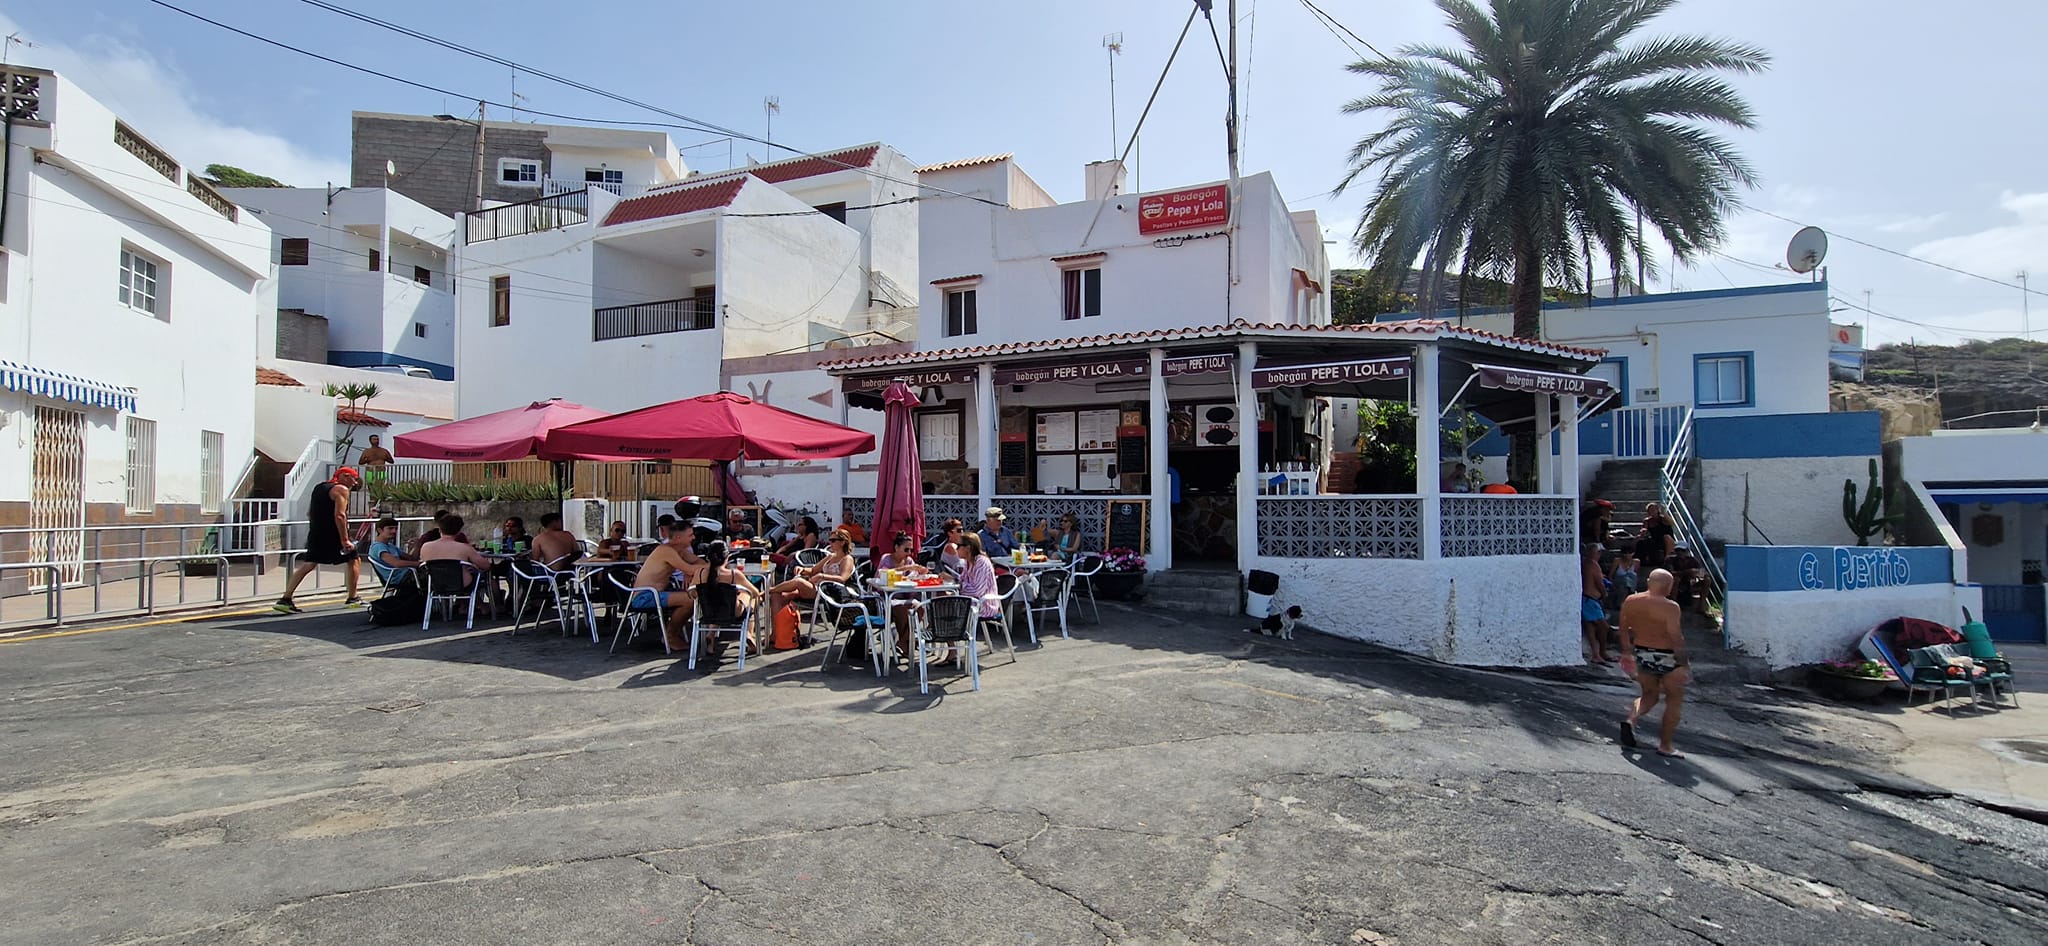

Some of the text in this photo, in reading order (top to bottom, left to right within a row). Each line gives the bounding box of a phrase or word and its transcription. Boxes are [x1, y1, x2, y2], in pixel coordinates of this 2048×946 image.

[1173, 190, 1217, 203] Bodegón
[1167, 200, 1223, 217] Pepe y Lola
[1189, 358, 1203, 370] PEPE
[1204, 358, 1209, 369] Y
[1209, 356, 1226, 368] LOLA
[917, 374, 924, 384] Y
[925, 372, 952, 384] LOLA
[1016, 363, 1121, 382] bodegón PEPE Y LOLA
[1268, 362, 1390, 384] bodegón PEPE Y LOLA
[1506, 373, 1586, 392] bodegón PEPE Y LOLA
